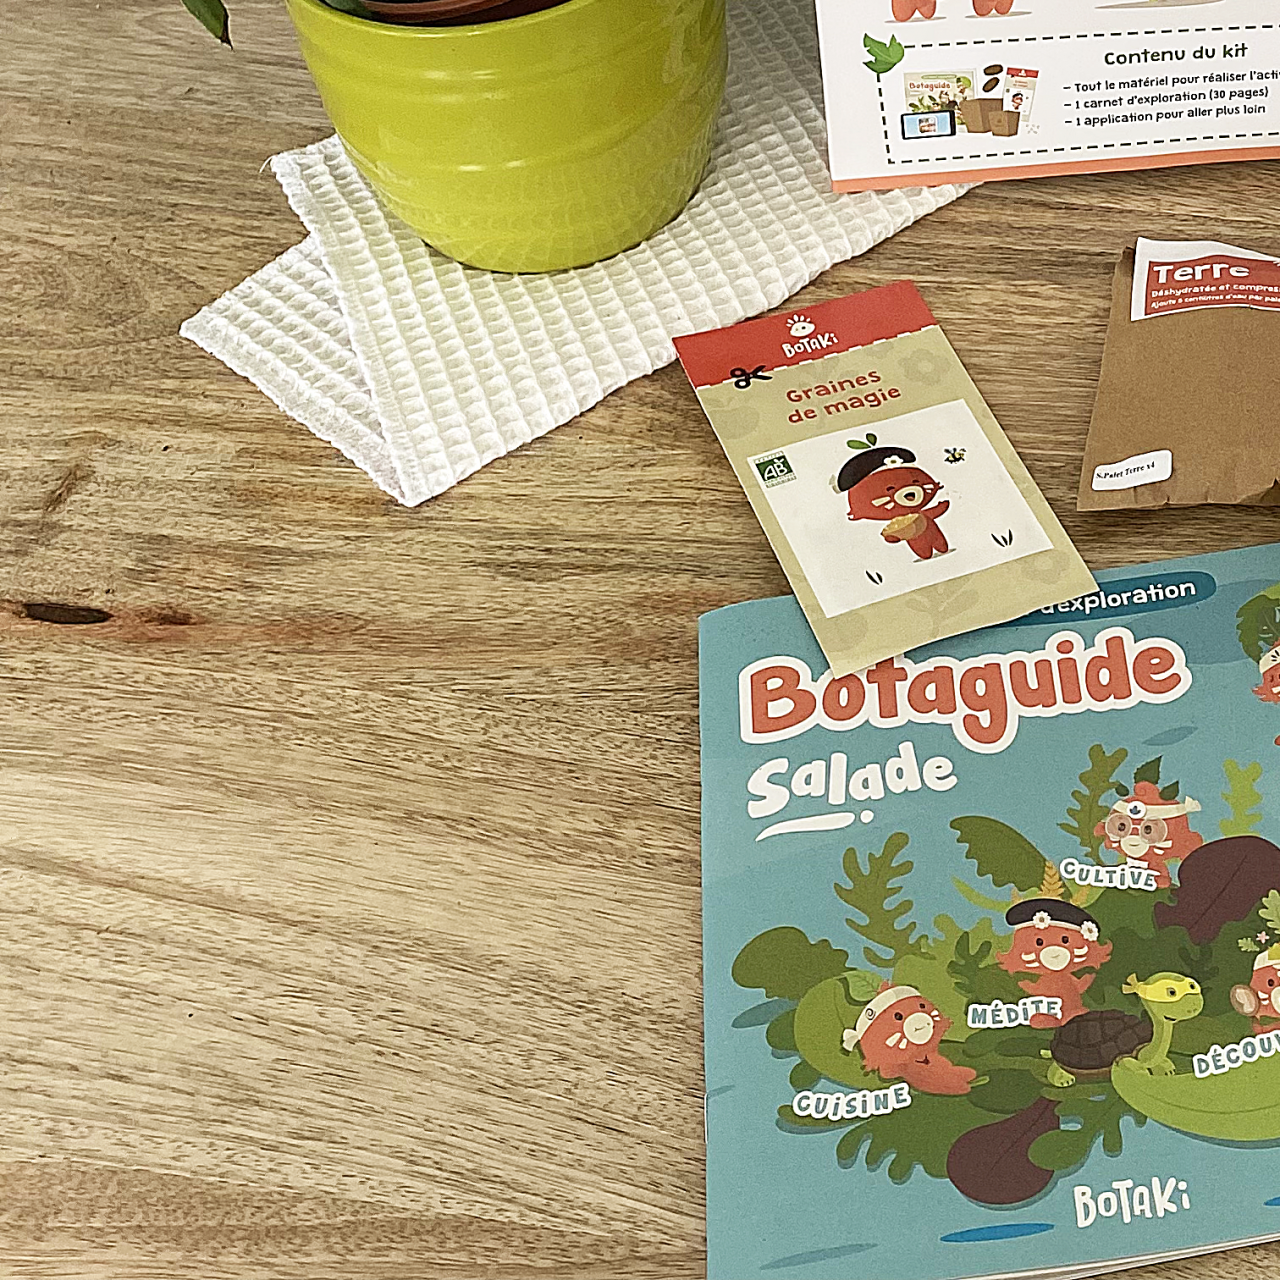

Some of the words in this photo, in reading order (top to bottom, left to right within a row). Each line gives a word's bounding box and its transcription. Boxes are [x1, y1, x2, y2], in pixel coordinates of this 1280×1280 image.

[1104, 47, 1186, 65] Contenu
[1192, 45, 1216, 62] du
[1222, 43, 1248, 59] kit
[1075, 82, 1101, 93] Tout
[1105, 81, 1115, 91] le
[1119, 76, 1168, 89] matériel
[1172, 75, 1200, 89] pour
[1203, 71, 1247, 84] réaliser
[1075, 100, 1080, 110] 1
[1083, 97, 1123, 109] carnet
[1127, 90, 1206, 106] d'exploration
[1209, 88, 1226, 100] (30
[1228, 86, 1269, 100] pages)
[1076, 117, 1081, 127] 1
[1083, 112, 1153, 128] application
[1156, 109, 1184, 123] pour
[1187, 106, 1213, 118] aller
[1215, 105, 1240, 119] plus
[1243, 104, 1266, 115] loin
[1153, 263, 1250, 284] Terre
[1151, 284, 1216, 298] Déshydratée
[1218, 283, 1231, 291] et
[786, 370, 882, 403] Graines
[788, 409, 818, 424] de
[823, 387, 901, 416] magie
[763, 462, 788, 480] AB
[1125, 466, 1145, 475] Terre
[744, 630, 1188, 749] Botaguide
[747, 741, 958, 818] Salade
